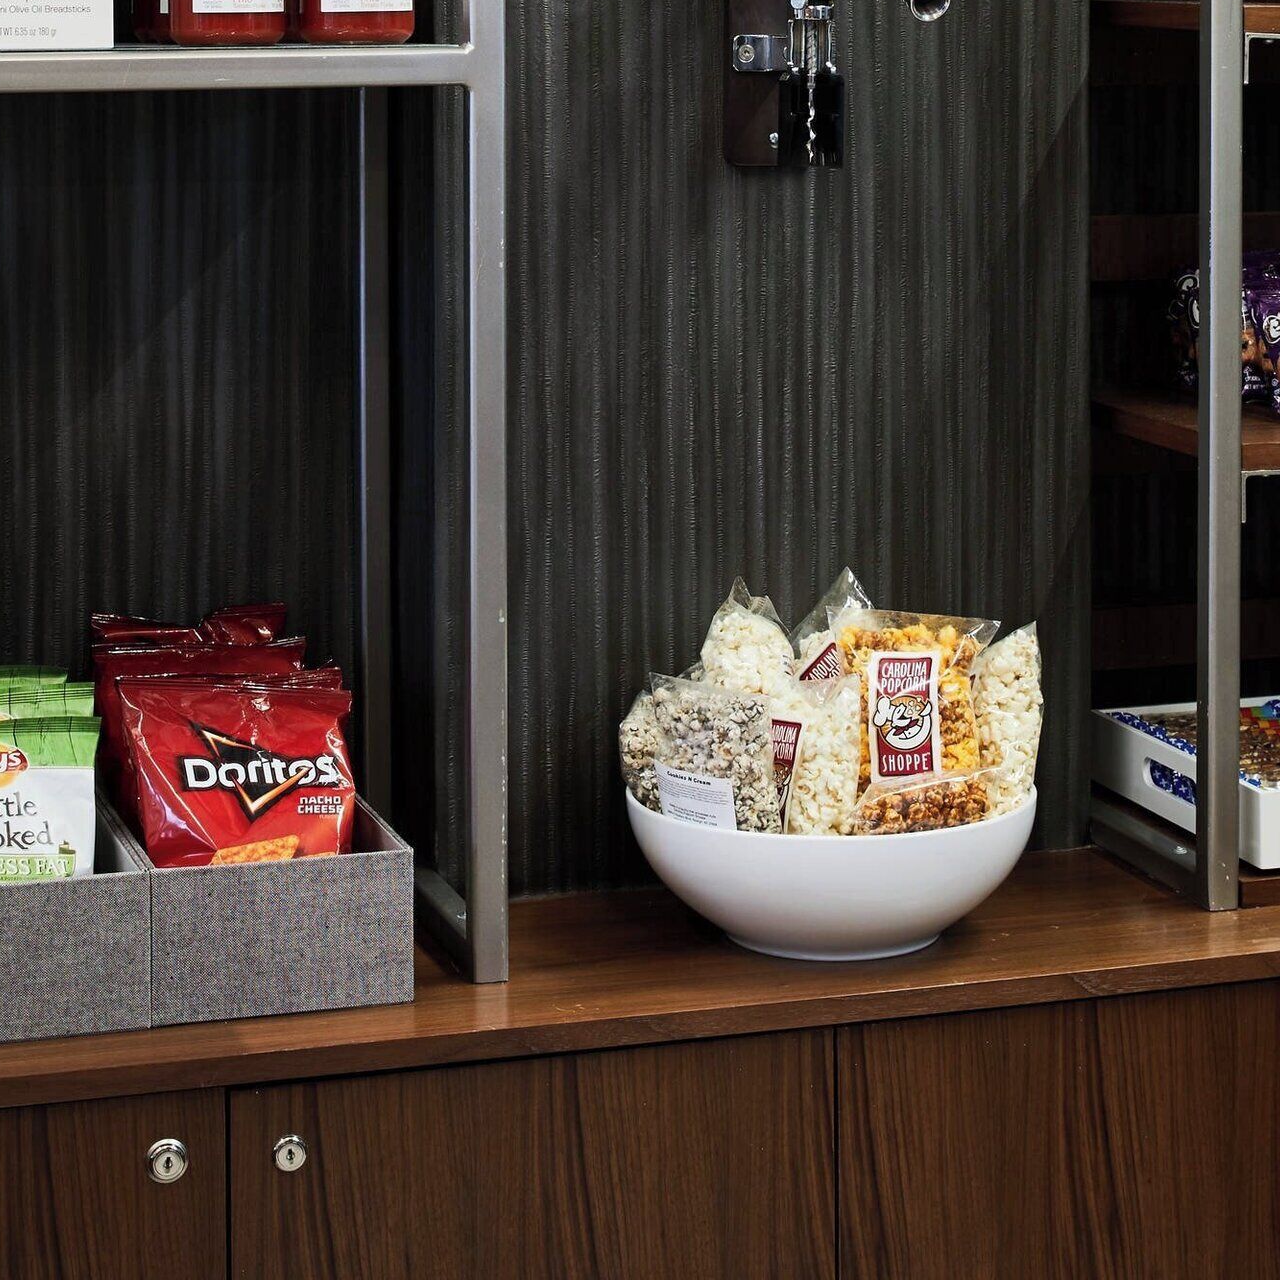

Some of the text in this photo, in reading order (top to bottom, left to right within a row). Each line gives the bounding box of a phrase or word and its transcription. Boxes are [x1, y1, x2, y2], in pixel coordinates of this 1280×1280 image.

[9, 5, 30, 13] Olive
[32, 5, 42, 13] Oil
[44, 5, 91, 13] Breadsticks
[881, 661, 927, 678] CAROLINA
[881, 676, 926, 693] POPCORN
[771, 724, 797, 744] AROLINA
[772, 742, 795, 761] PCORN
[882, 753, 929, 772] SHOPPE
[183, 756, 340, 789] Doritos
[693, 778, 711, 786] Cream
[298, 804, 343, 814] CHEESE
[300, 796, 341, 805] NACHO
[35, 858, 70, 878] FAT
